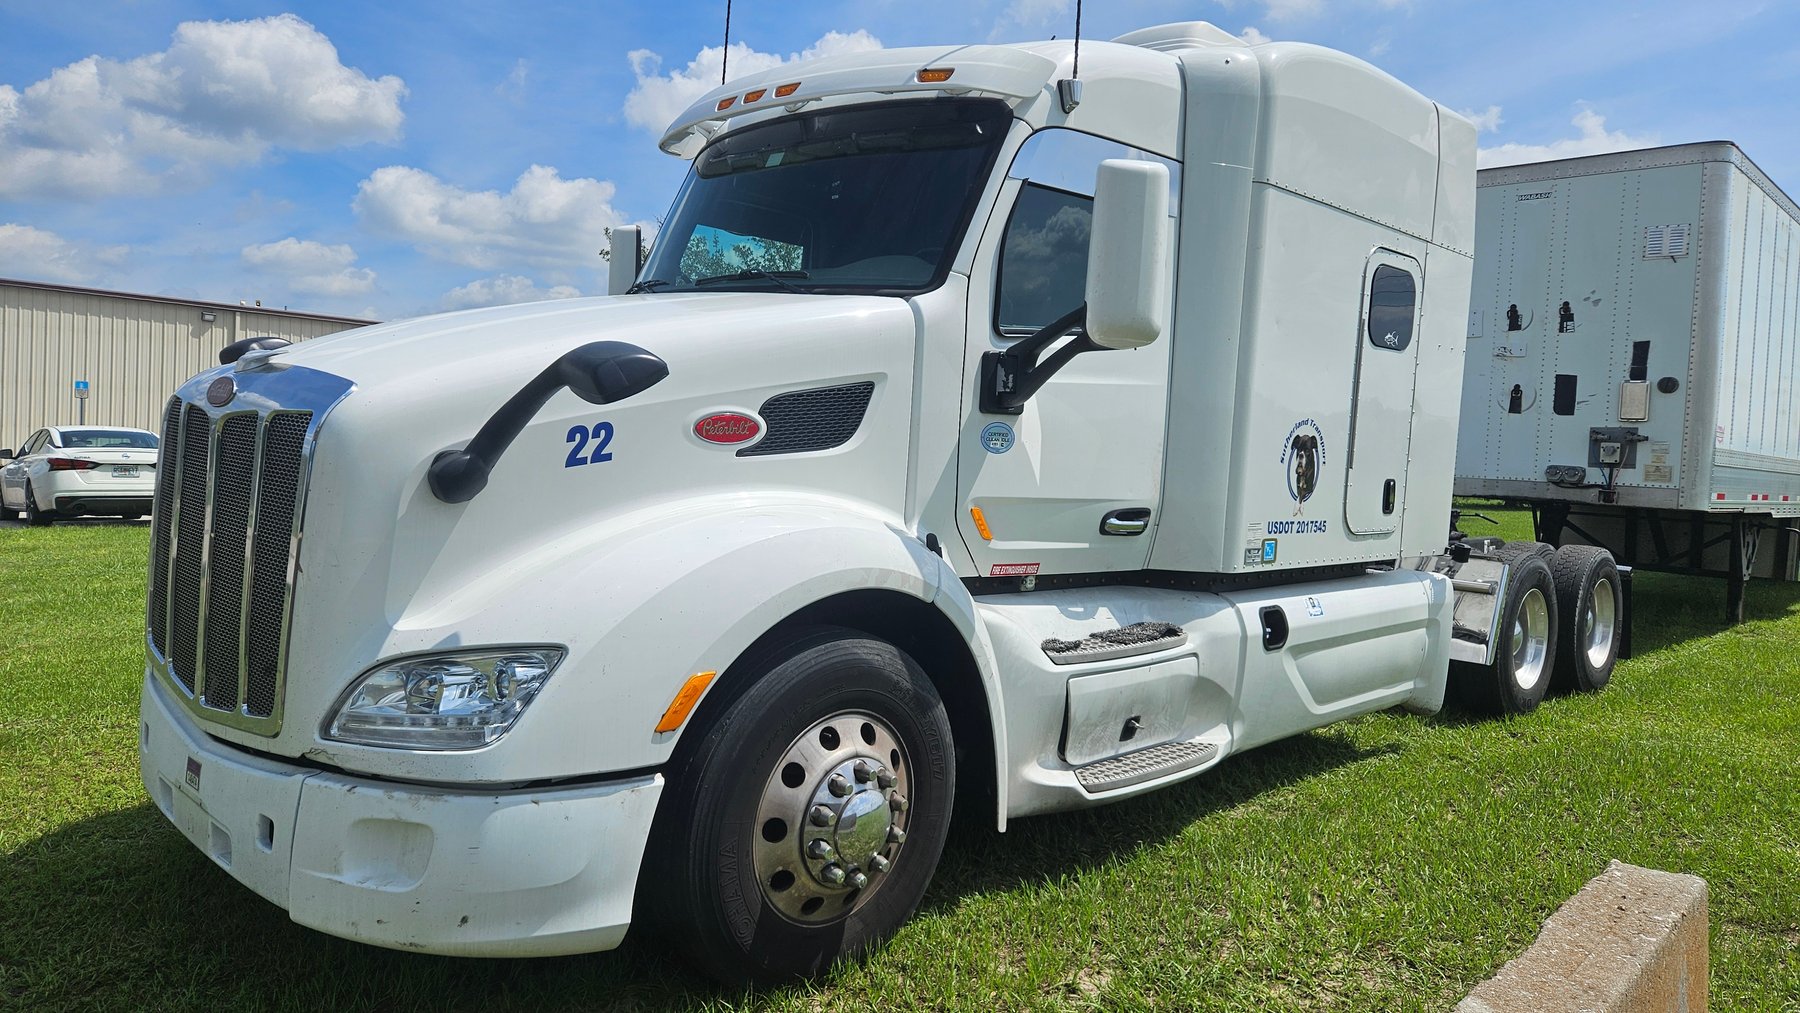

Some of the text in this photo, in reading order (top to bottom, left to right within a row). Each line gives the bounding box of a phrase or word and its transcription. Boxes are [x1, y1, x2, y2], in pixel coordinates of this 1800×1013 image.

[1518, 192, 1553, 202] WABASH
[702, 419, 755, 436] Peterbilt
[564, 421, 615, 469] 22
[1279, 417, 1327, 466] Sutherland Transport
[1267, 521, 1295, 535] USDOT
[1295, 520, 1327, 534] 2017545
[991, 564, 1039, 575] FIRE EXTINGUISHER INSIDE
